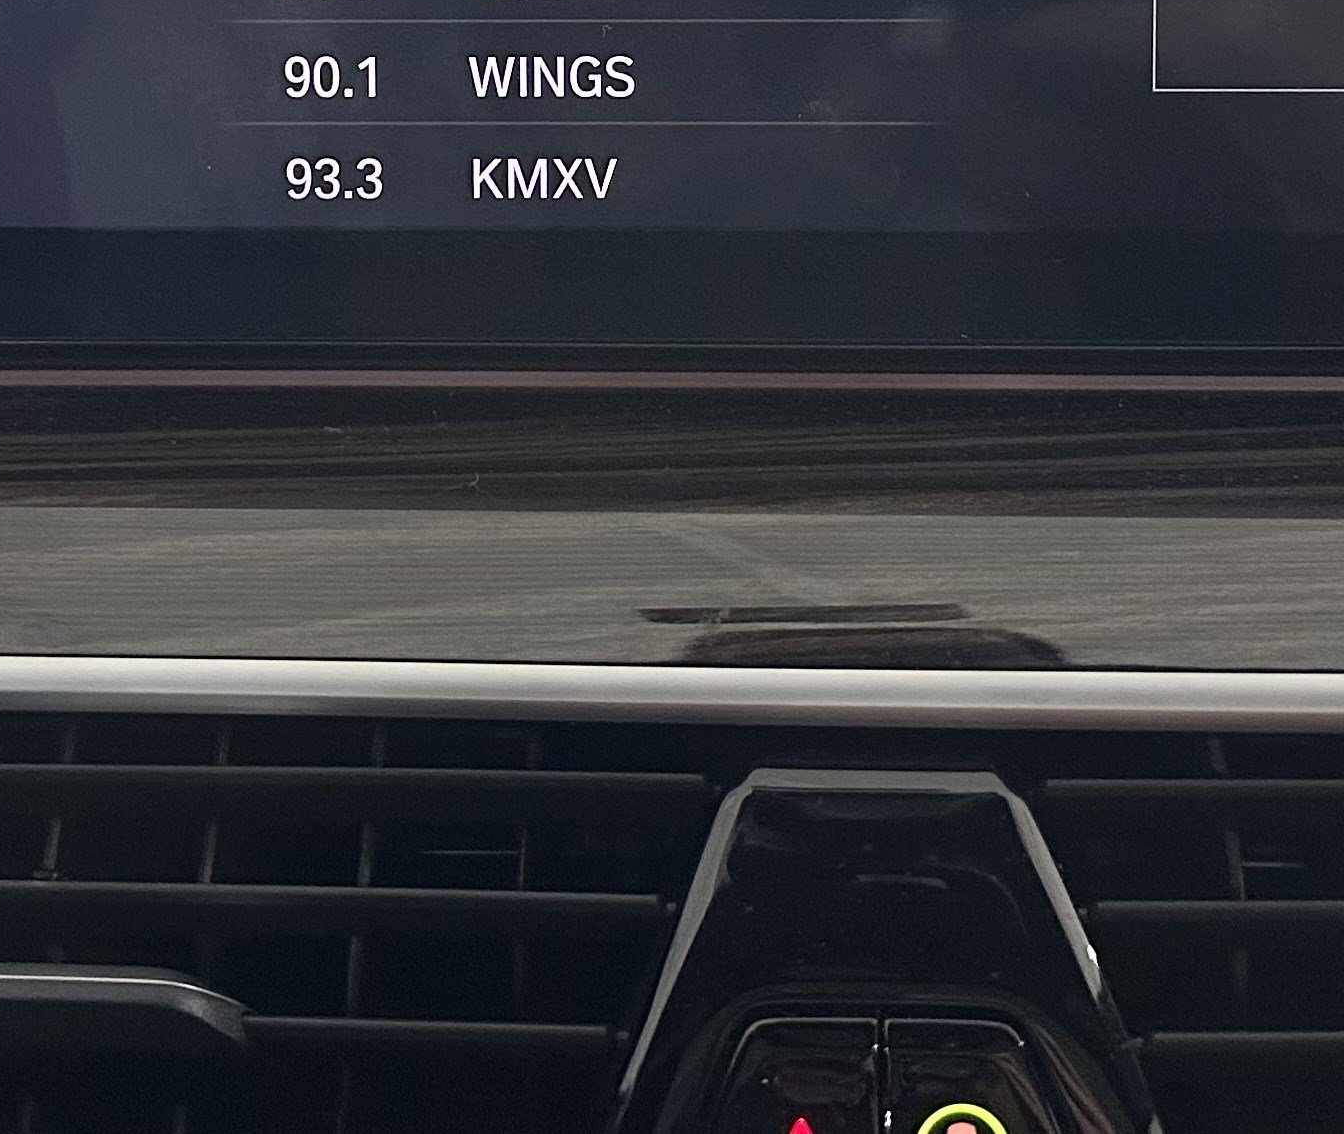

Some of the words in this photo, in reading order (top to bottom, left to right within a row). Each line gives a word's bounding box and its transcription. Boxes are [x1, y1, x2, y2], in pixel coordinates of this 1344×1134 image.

[284, 55, 377, 98] 90.1
[468, 55, 635, 98] WINGS
[286, 157, 383, 200] 93.3
[472, 158, 618, 199] KMXV
